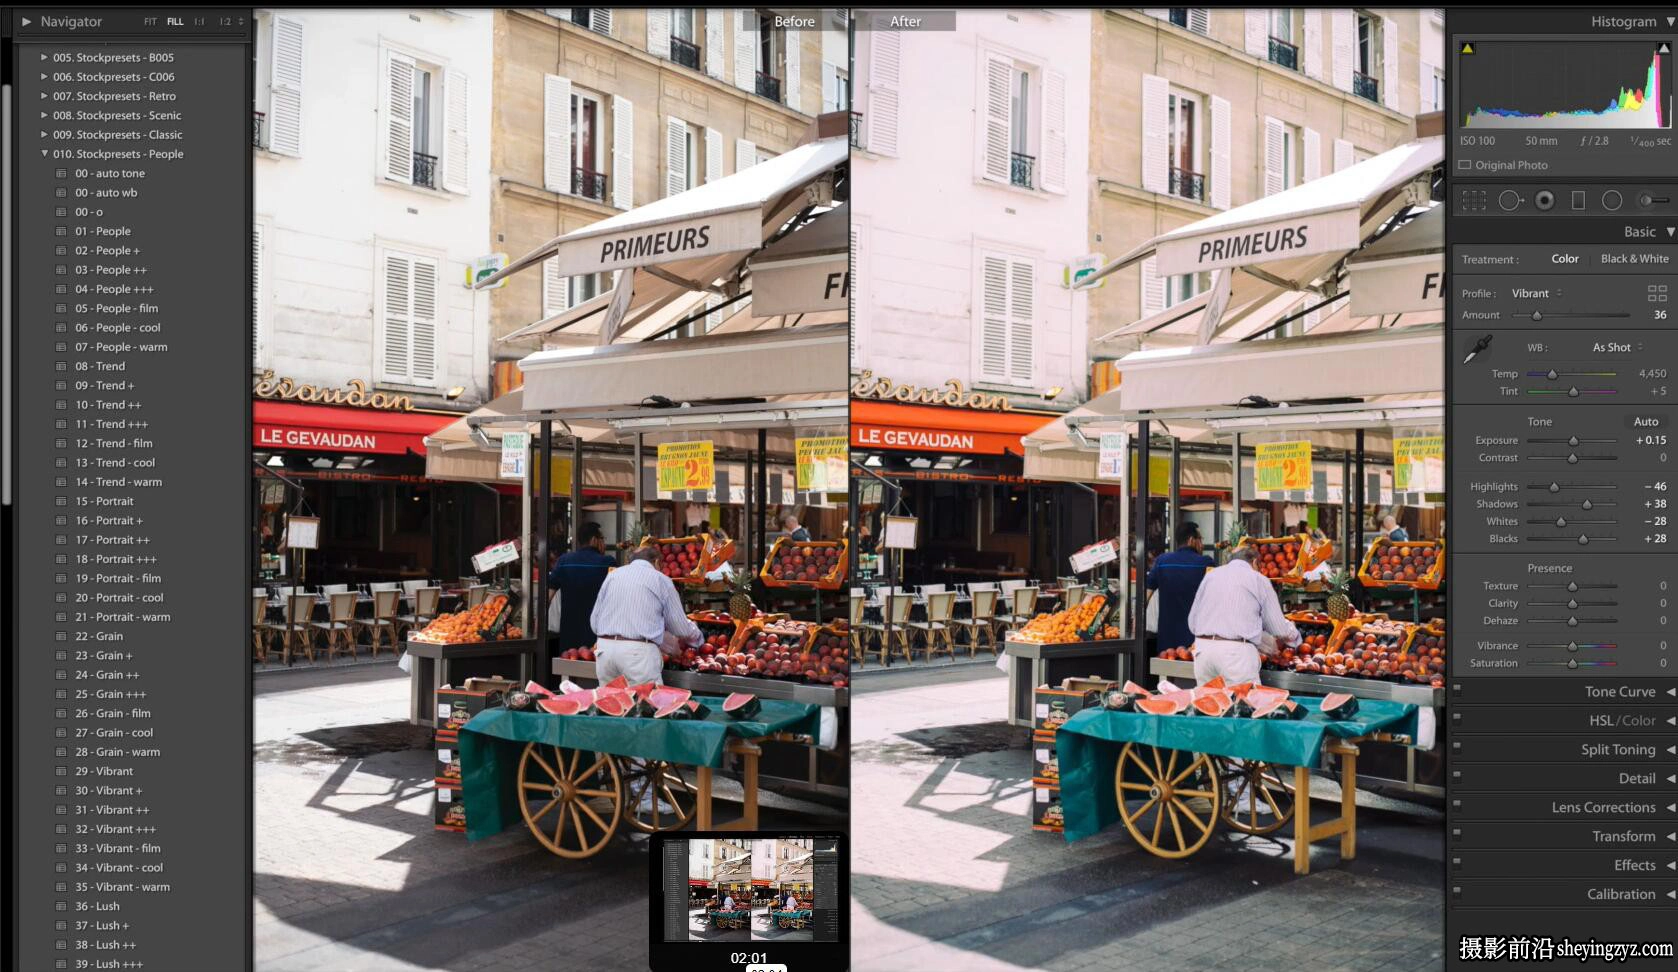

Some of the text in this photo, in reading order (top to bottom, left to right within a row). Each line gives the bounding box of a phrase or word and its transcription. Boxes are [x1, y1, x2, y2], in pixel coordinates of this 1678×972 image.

[40, 15, 103, 31] Navigator
[144, 17, 158, 26] FIT
[166, 16, 185, 26] FILL
[775, 16, 815, 27] Before
[890, 16, 922, 27] After
[1591, 15, 1657, 31] Histogram
[53, 52, 174, 65] 005. Stockpresets B005
[53, 71, 175, 84] 006. Stockpresets C006
[53, 91, 177, 103] 007. Stockpresets Retro
[53, 110, 182, 123] 008. Stockpresets Scenic
[53, 129, 183, 142] 009. Stockpresets Classic
[1460, 135, 1496, 146] ISO 100
[1525, 135, 1558, 146] 50 mm
[1656, 137, 1672, 146] sec
[53, 148, 184, 161] 010. Stockpresets People
[1475, 160, 1549, 173] Original Photo
[75, 226, 132, 239] 01 People
[1624, 225, 1657, 238] Basic
[600, 224, 710, 263] PRIMEURS
[1198, 225, 1309, 263] PRIMEURS
[1551, 253, 1580, 264] Color
[1601, 253, 1670, 264] Black & White
[1511, 288, 1550, 299] Vibrant
[75, 302, 159, 316] 05 People film
[1654, 309, 1668, 320] 36
[1462, 310, 1500, 320] Amount
[1592, 342, 1632, 353] As Shot
[75, 360, 126, 371] 08 Trend
[1491, 369, 1519, 380] Temp
[1639, 368, 1667, 379] 4,450
[1499, 386, 1519, 396] Tint
[1527, 416, 1553, 427] Tone
[1633, 416, 1660, 427] Auto
[76, 437, 153, 449] 12 Trend film
[261, 429, 376, 449] LE GEVAUDAN
[859, 429, 974, 449] LE GEVAUDAN
[1475, 435, 1519, 447] Exposure
[1478, 453, 1519, 462] Contrast
[1660, 452, 1667, 462] 0
[318, 471, 371, 481] BISTRO
[916, 471, 969, 481] BISTRO
[1470, 481, 1519, 494] Highlights
[76, 496, 134, 507] 15 Portrait
[1476, 498, 1519, 509] Shadows
[1486, 516, 1519, 526] Whites
[1489, 533, 1519, 543] Blacks
[1527, 563, 1573, 573] Presence
[1483, 581, 1519, 591] Texture
[1660, 580, 1667, 591] 0
[75, 592, 164, 603] 20 Portrait cool
[1660, 598, 1667, 608] 0
[1488, 598, 1519, 610] Clarity
[1483, 615, 1519, 625] Dehaze
[1660, 615, 1667, 625] 0
[75, 631, 124, 641] 22 Grain
[1477, 641, 1519, 651] Vibrance
[1660, 640, 1667, 650] 0
[1470, 658, 1519, 668] Saturation
[1660, 657, 1667, 668] 0
[1584, 685, 1657, 698] Tone Curve
[75, 746, 161, 757] 28 Grain warm
[1581, 743, 1656, 759] Split Toning
[75, 765, 134, 776] 29 Vibrant
[1619, 771, 1656, 785] Detail
[1552, 801, 1657, 814] Lens Corrections
[1591, 829, 1656, 843] Transform
[1614, 858, 1657, 872] Effects
[1587, 887, 1656, 900] Calibration
[75, 900, 120, 912] 36 Lush
